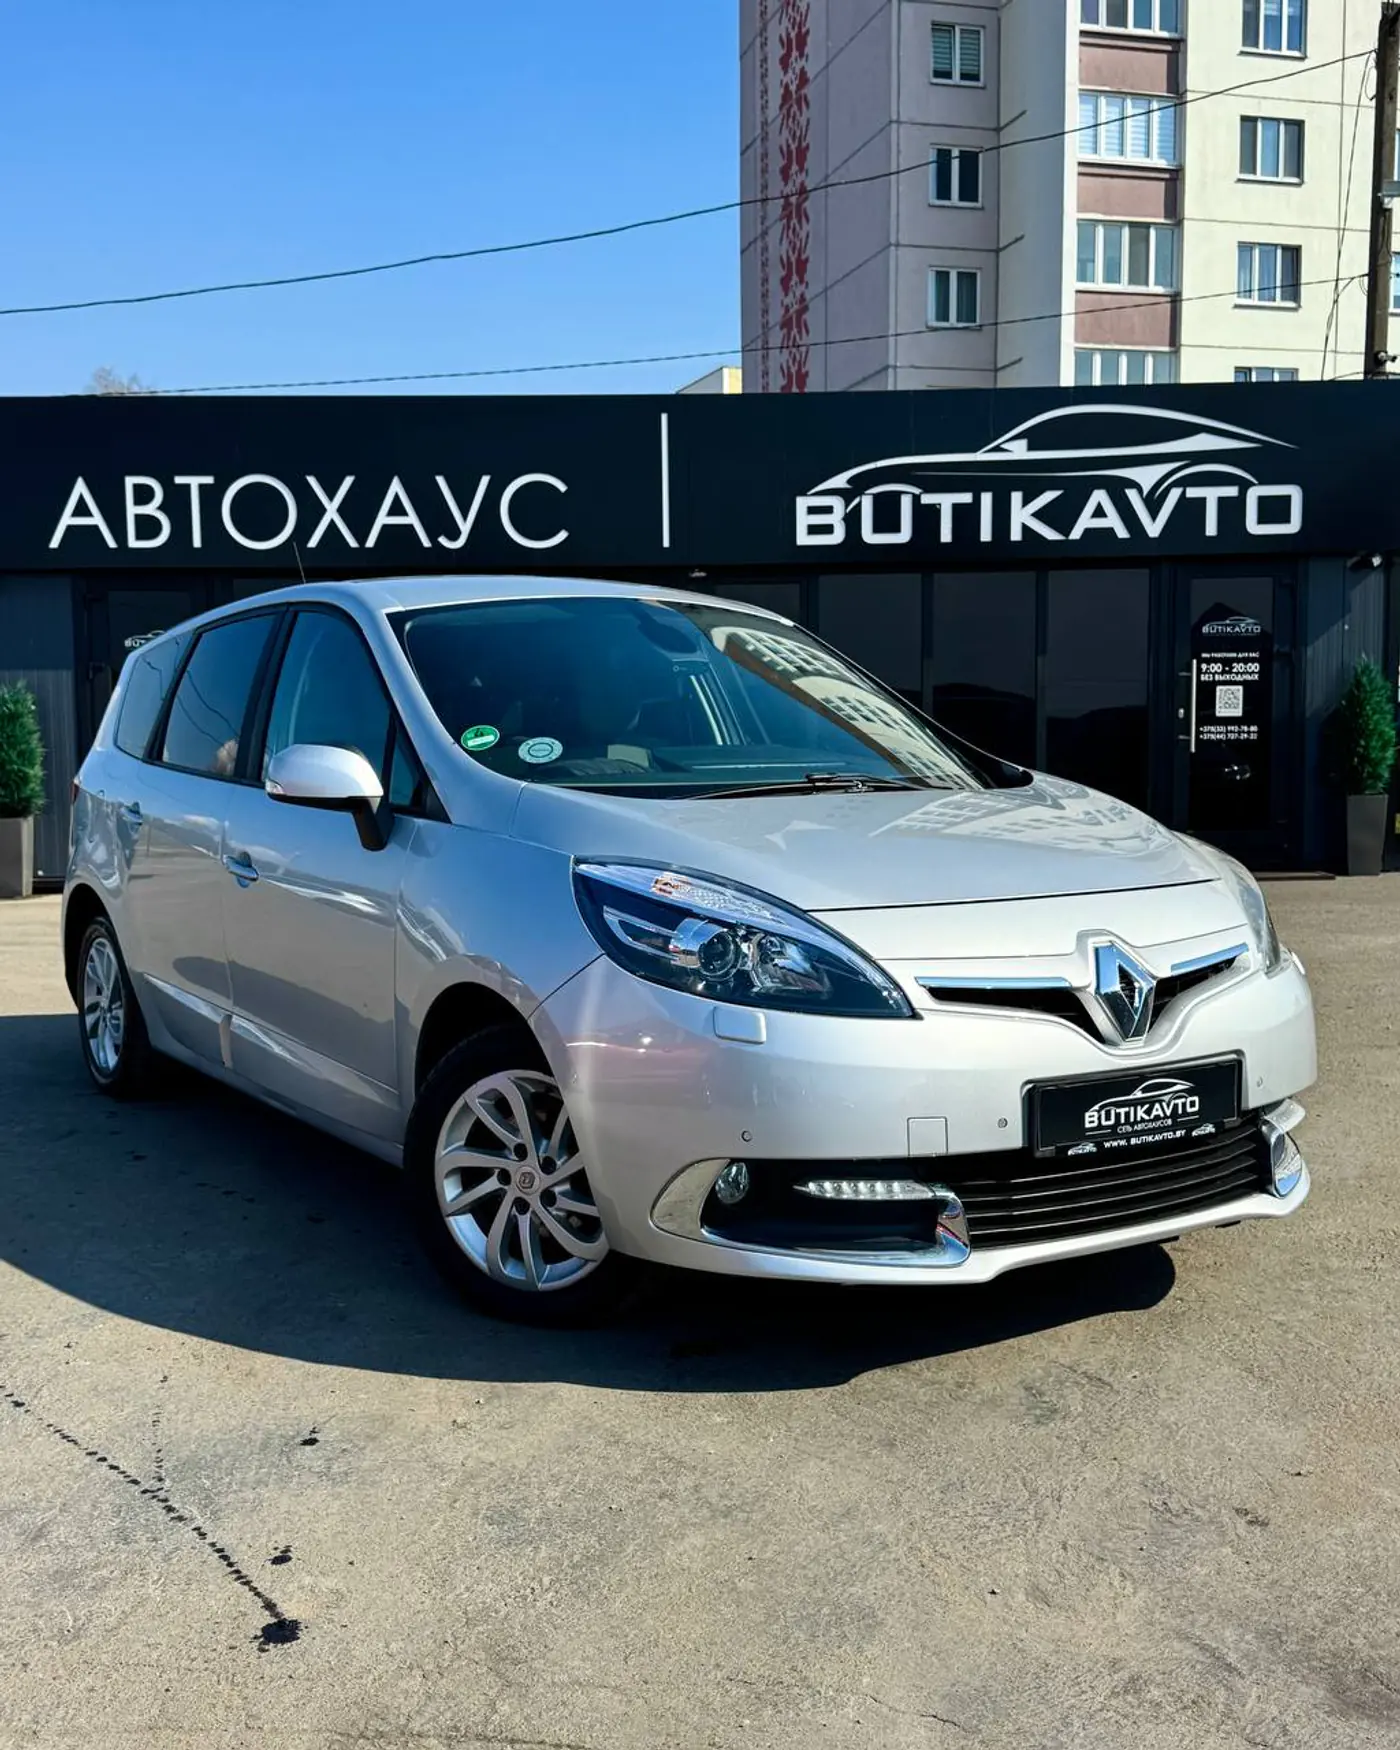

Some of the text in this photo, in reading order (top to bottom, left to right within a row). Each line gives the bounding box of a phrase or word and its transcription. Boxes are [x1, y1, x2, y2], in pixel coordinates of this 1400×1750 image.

[48, 473, 570, 550] АВТОХАУС
[795, 484, 1303, 546] BUTIKAVTO
[1200, 673, 1259, 681] БЕЗ ВЫХОДНЫХ
[1201, 662, 1222, 673] 9:00
[1231, 662, 1260, 673] 20:00
[1085, 1096, 1199, 1128] BUTIKAVTO
[1130, 1129, 1186, 1145] BUTIKAVTO.BY
